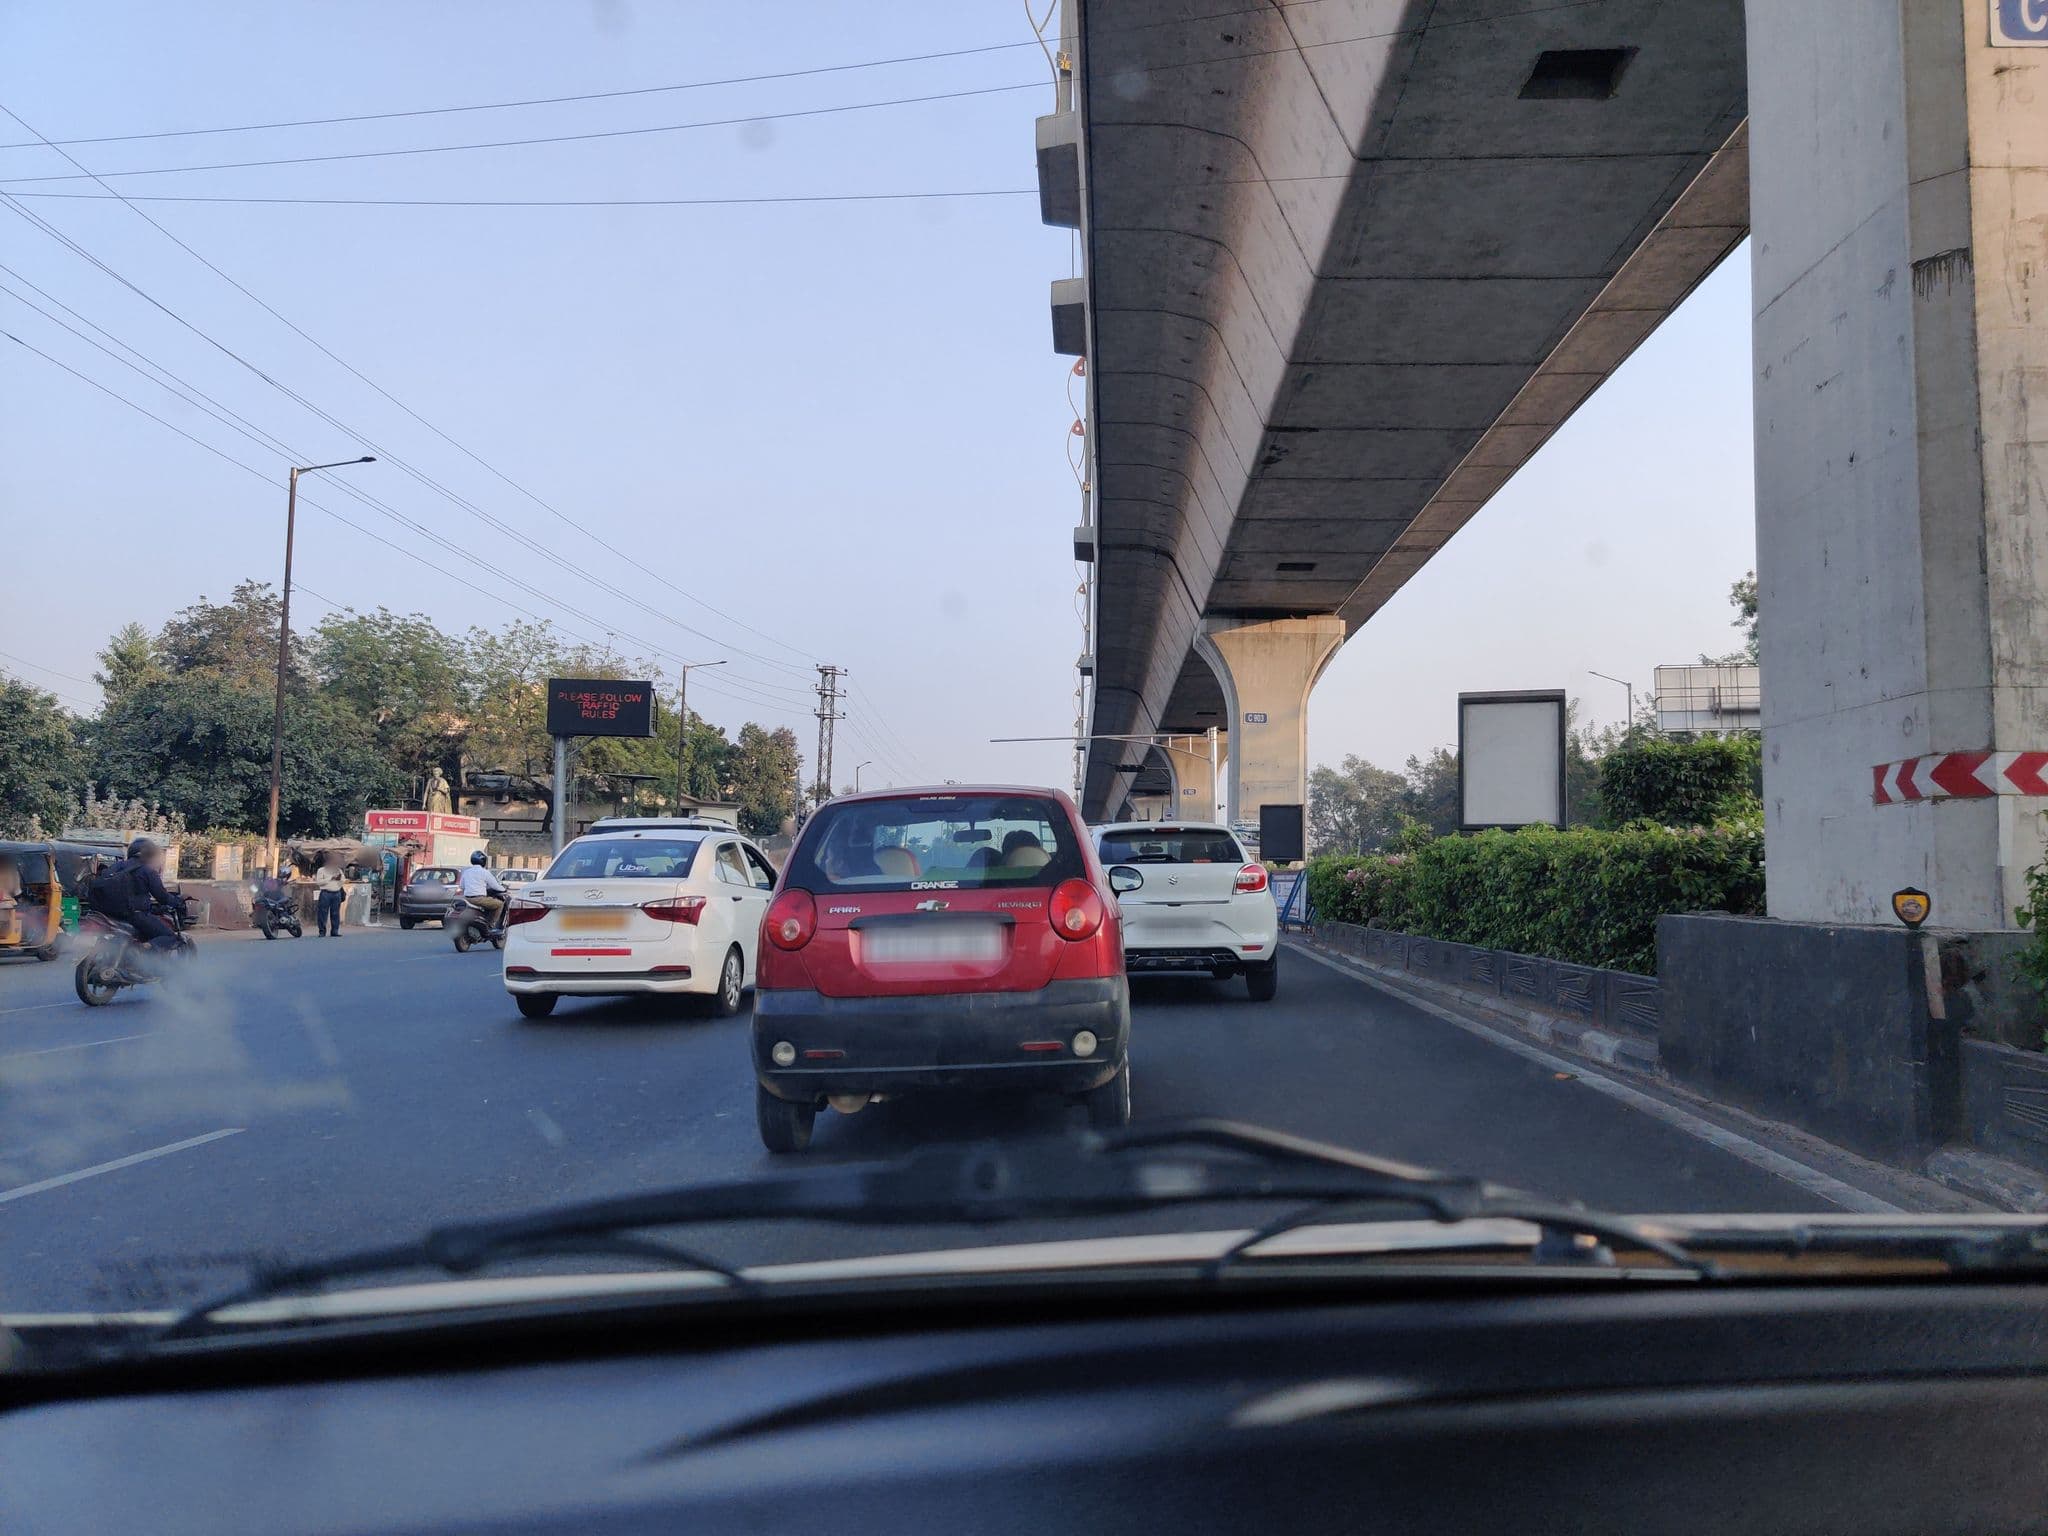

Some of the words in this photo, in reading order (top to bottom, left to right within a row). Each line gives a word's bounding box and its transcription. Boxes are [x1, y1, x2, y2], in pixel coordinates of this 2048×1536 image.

[558, 691, 598, 702] PLEASE
[600, 693, 642, 703] FOLLOW
[578, 701, 620, 711] TRAFFIC
[581, 710, 616, 719] RULES
[387, 817, 419, 825] GENTS
[911, 880, 959, 890] ORANGE
